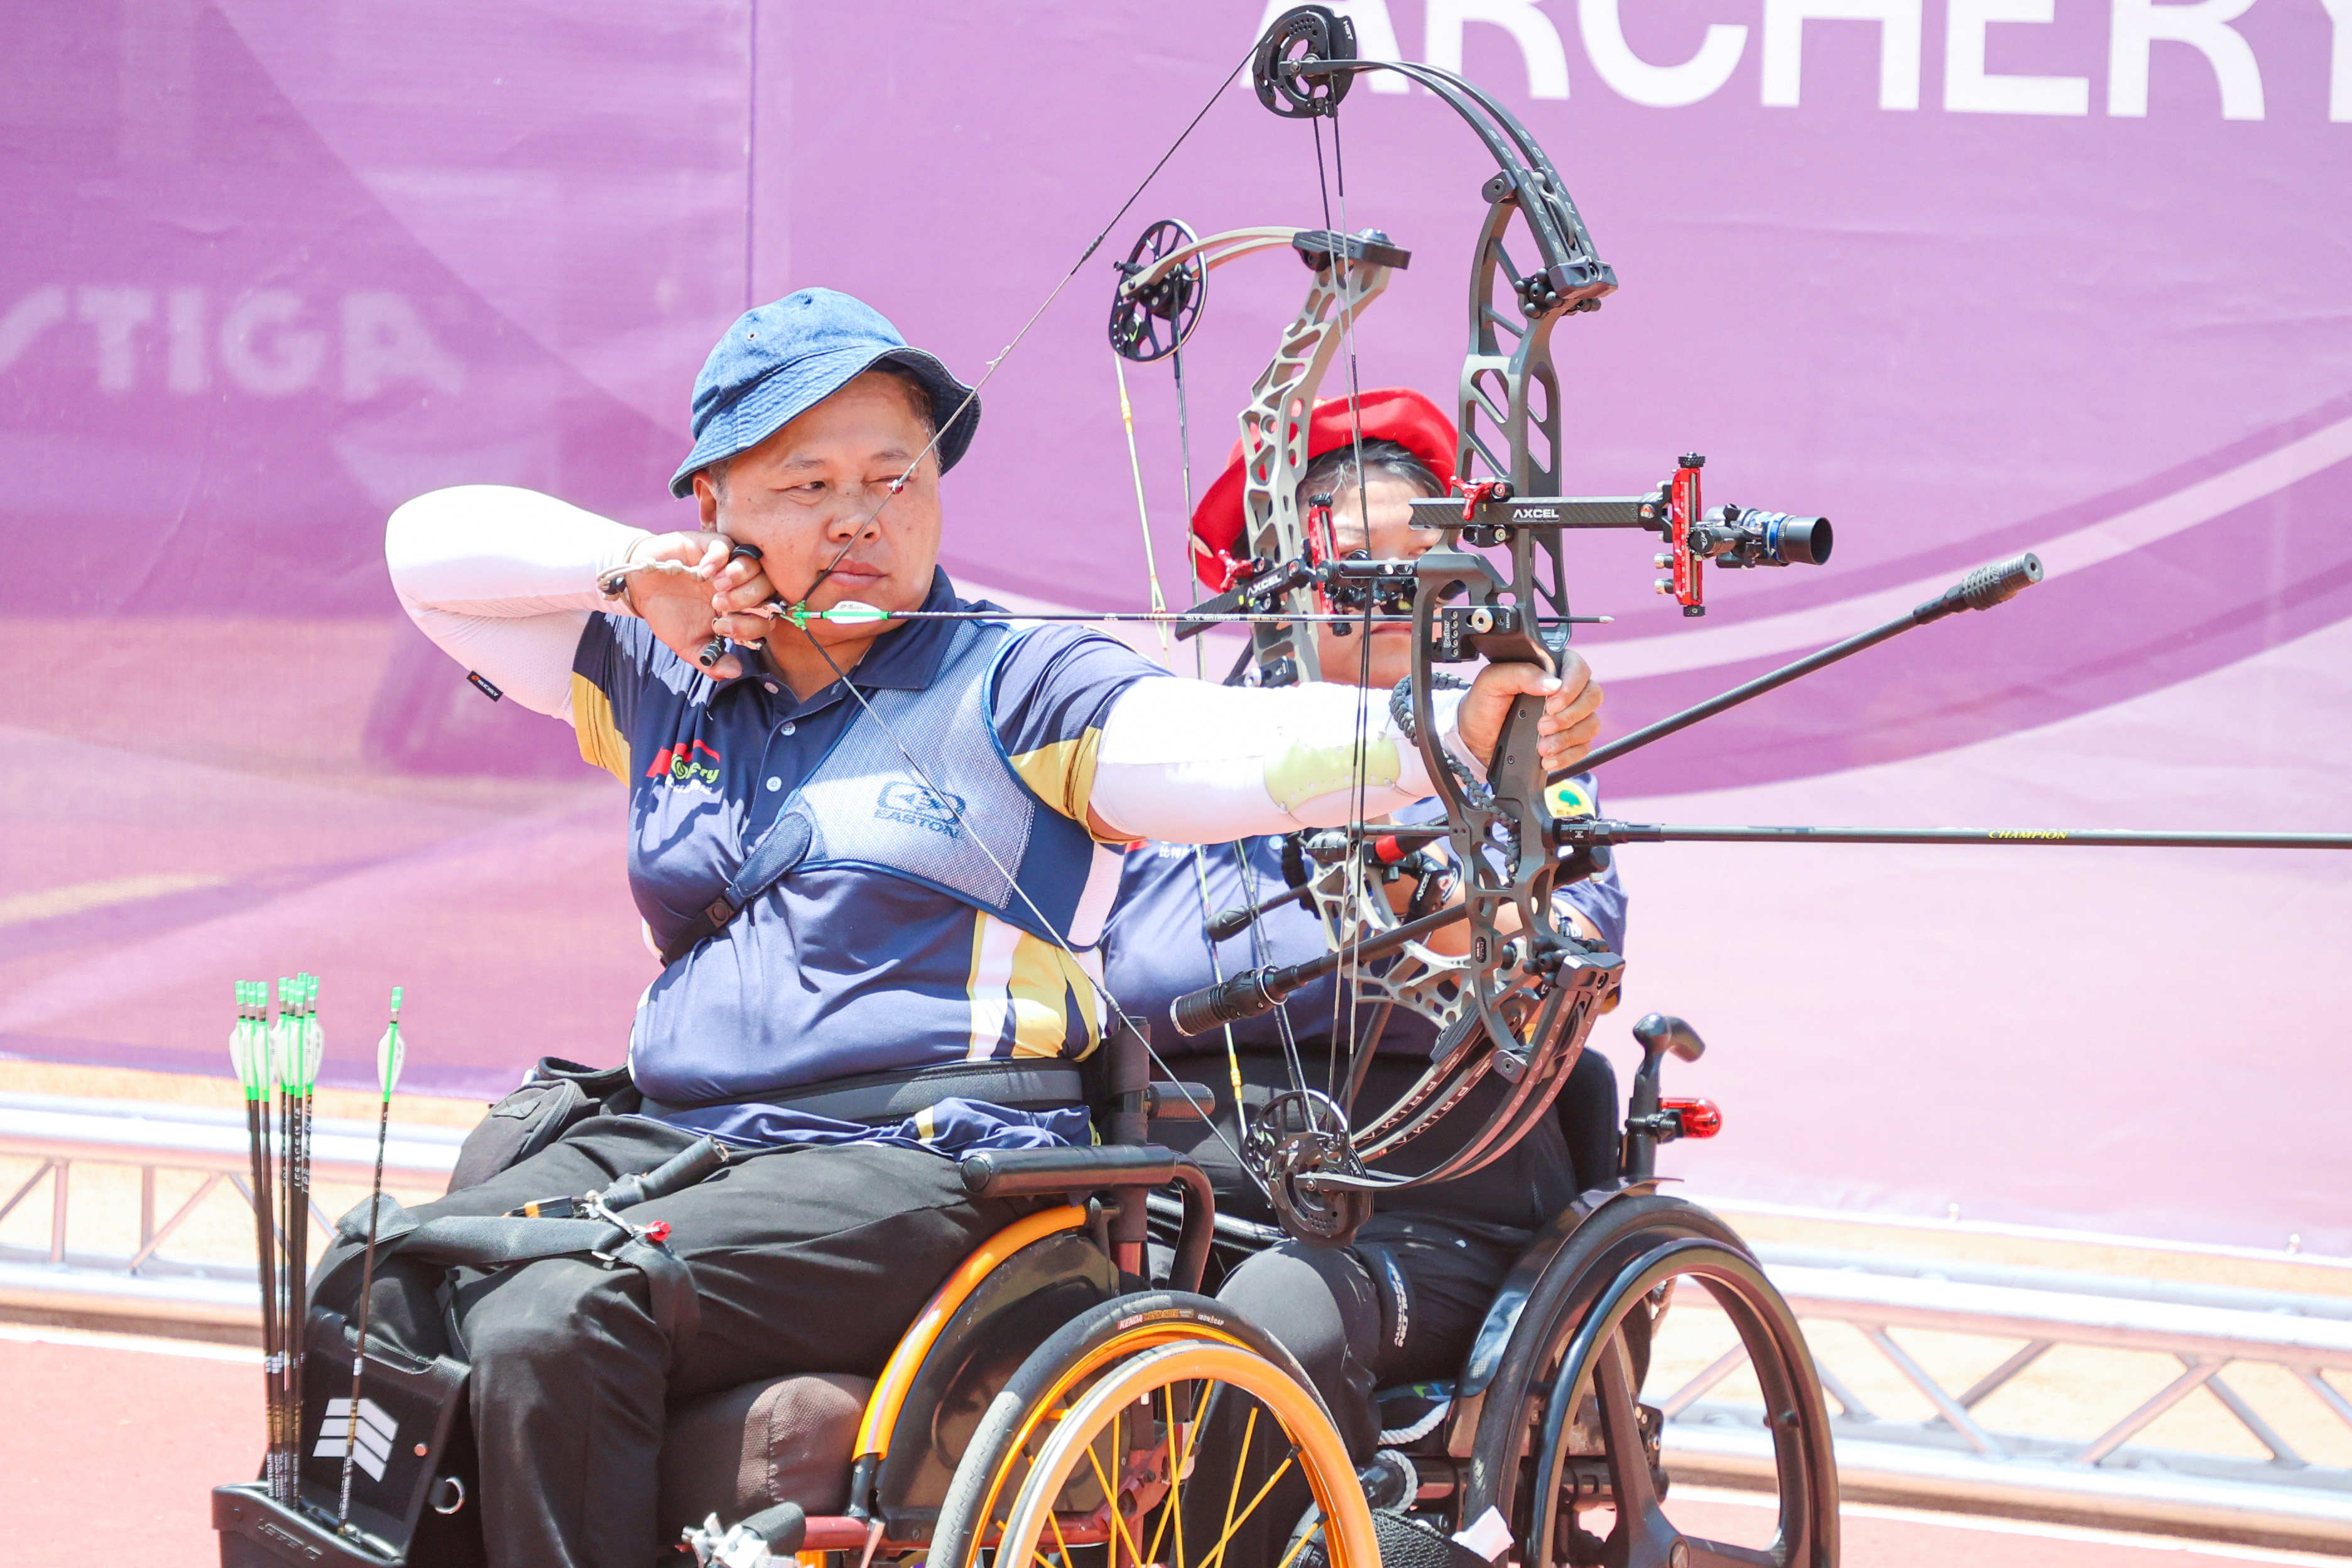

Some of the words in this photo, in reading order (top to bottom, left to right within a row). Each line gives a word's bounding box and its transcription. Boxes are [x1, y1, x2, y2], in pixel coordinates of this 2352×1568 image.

[1239, 0, 2352, 122] RCHER
[1513, 508, 1560, 518] AXCEL
[1246, 573, 1283, 597] AXCEL
[874, 808, 964, 839] EASTON
[1987, 830, 2069, 840] CHAMPION
[1416, 873, 1432, 901] AXCEL
[1363, 1081, 1438, 1140] PRIMA
[1394, 1086, 1470, 1145] PRIMA
[1119, 1314, 1143, 1330] KENDA
